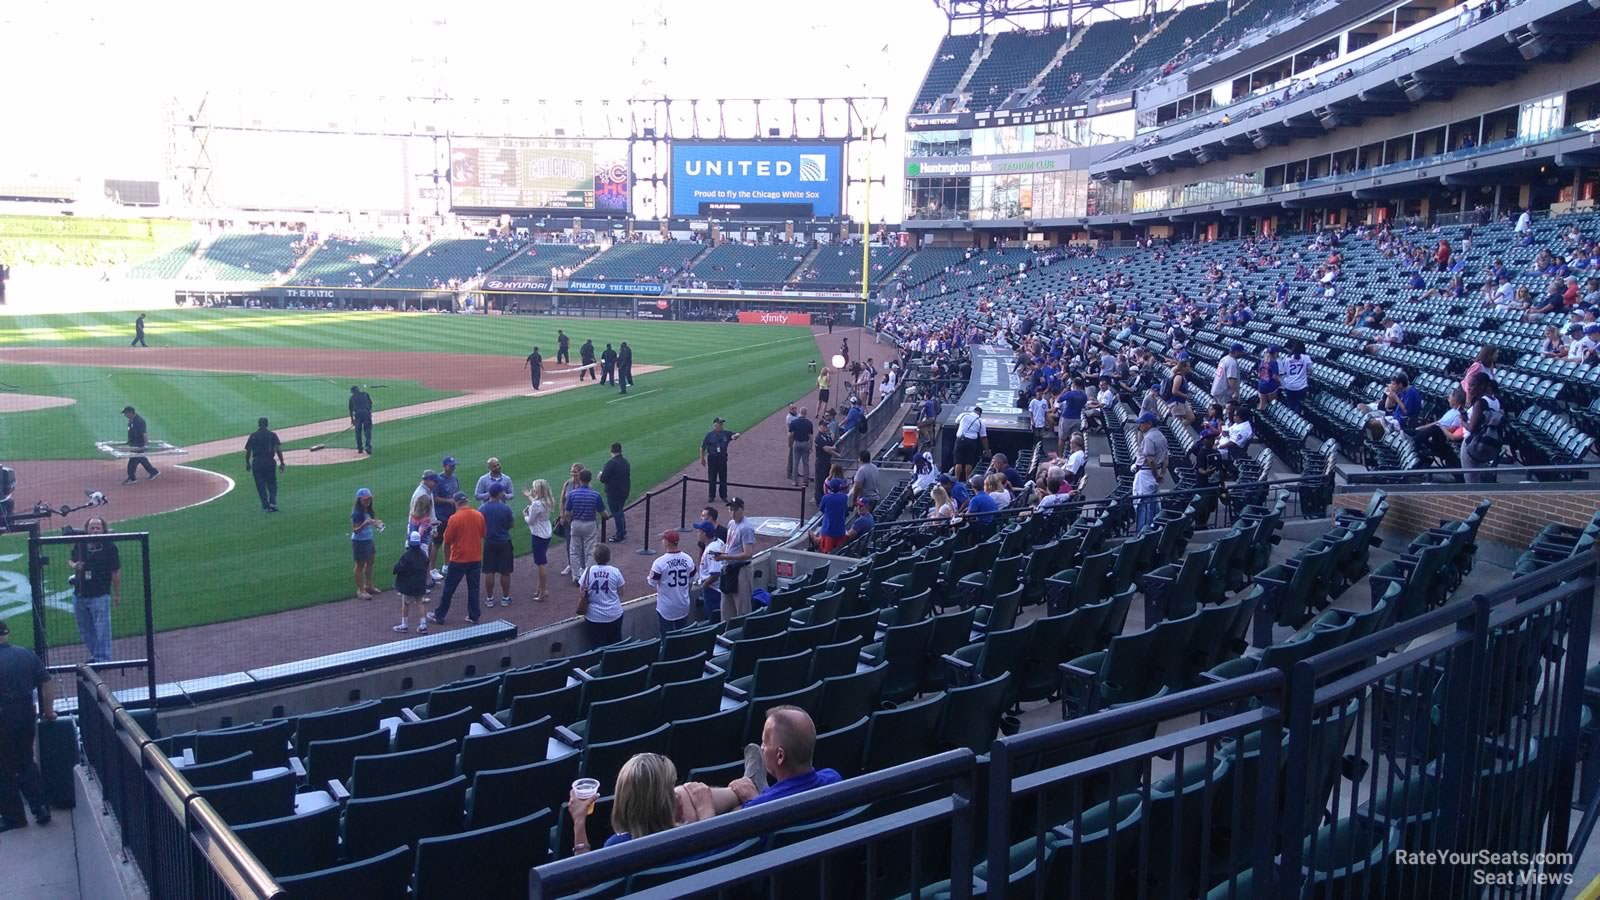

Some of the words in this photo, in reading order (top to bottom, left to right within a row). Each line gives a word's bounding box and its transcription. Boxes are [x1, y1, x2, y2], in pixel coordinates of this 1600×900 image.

[685, 160, 792, 176] UNITED
[920, 162, 970, 175] Huntington
[971, 161, 992, 172] Bank
[999, 161, 1033, 170] STADIUM
[1035, 160, 1055, 169] CLUB
[694, 190, 716, 198] Proud
[718, 190, 726, 198] to
[726, 190, 737, 200] fly
[739, 190, 750, 198] the
[752, 190, 781, 199] Chicago
[782, 190, 805, 198] White
[805, 191, 820, 199] Sox
[570, 281, 606, 290] ATHLETICO
[624, 284, 662, 292] RELIEVERS
[760, 315, 788, 324] xfinity
[1289, 364, 1304, 375] 27
[666, 558, 688, 568] THOMAS
[668, 569, 687, 587] 35
[590, 580, 609, 594] 44
